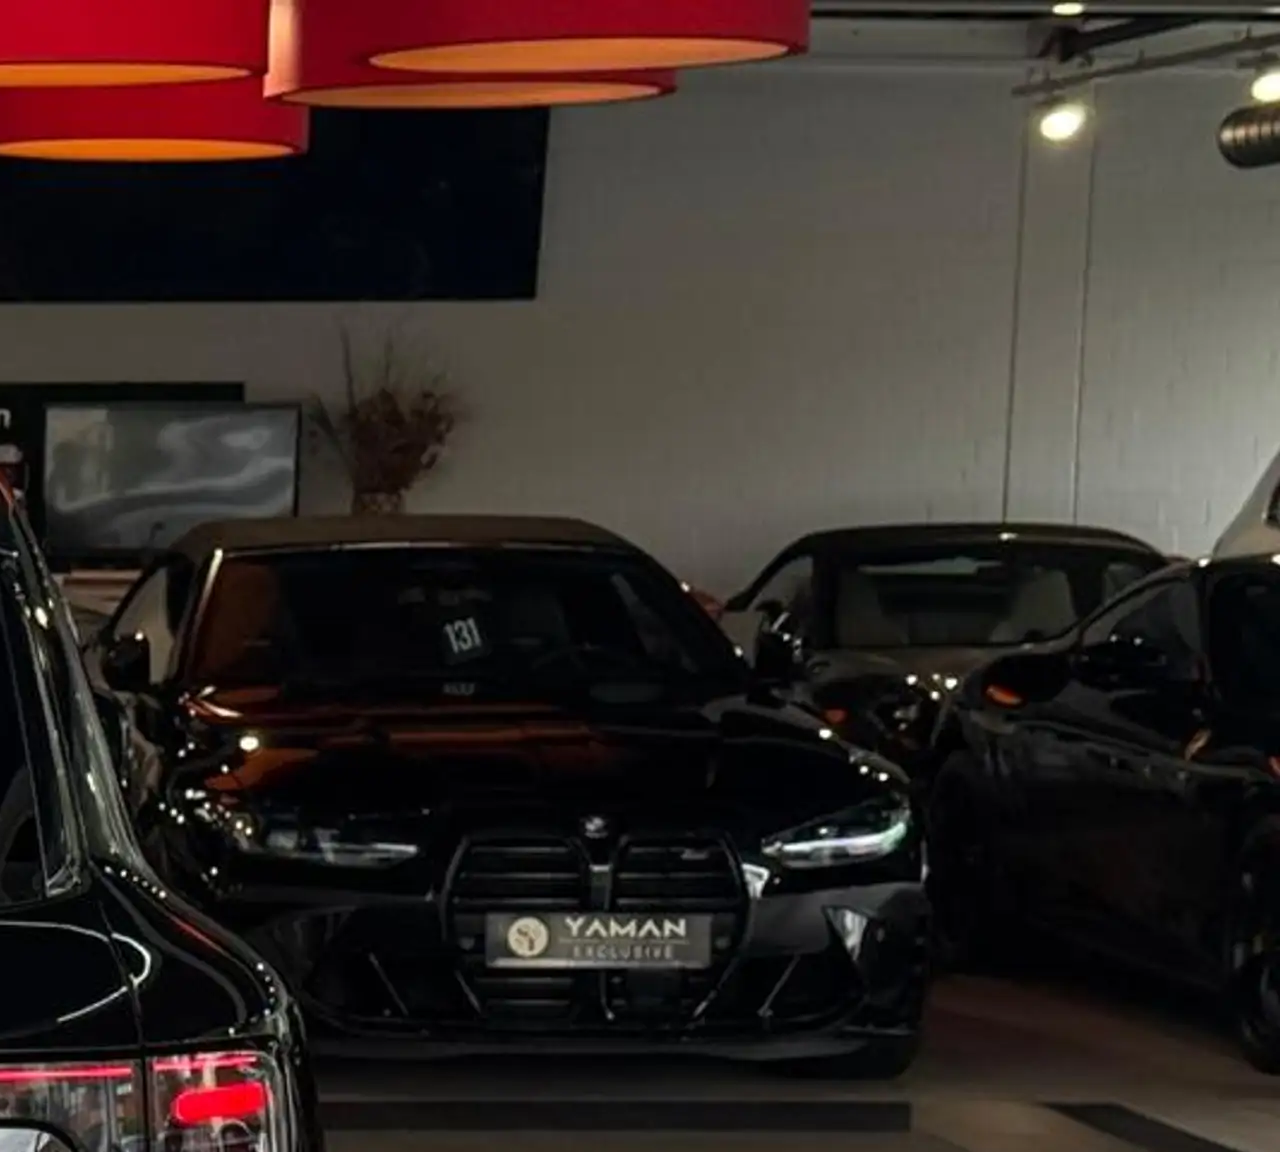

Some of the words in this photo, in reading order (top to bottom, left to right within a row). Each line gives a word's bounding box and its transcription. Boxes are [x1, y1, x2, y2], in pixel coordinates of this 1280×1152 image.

[444, 617, 482, 654] 131
[565, 917, 687, 938] YAMAN
[573, 945, 674, 960] EXCLUSIVE
